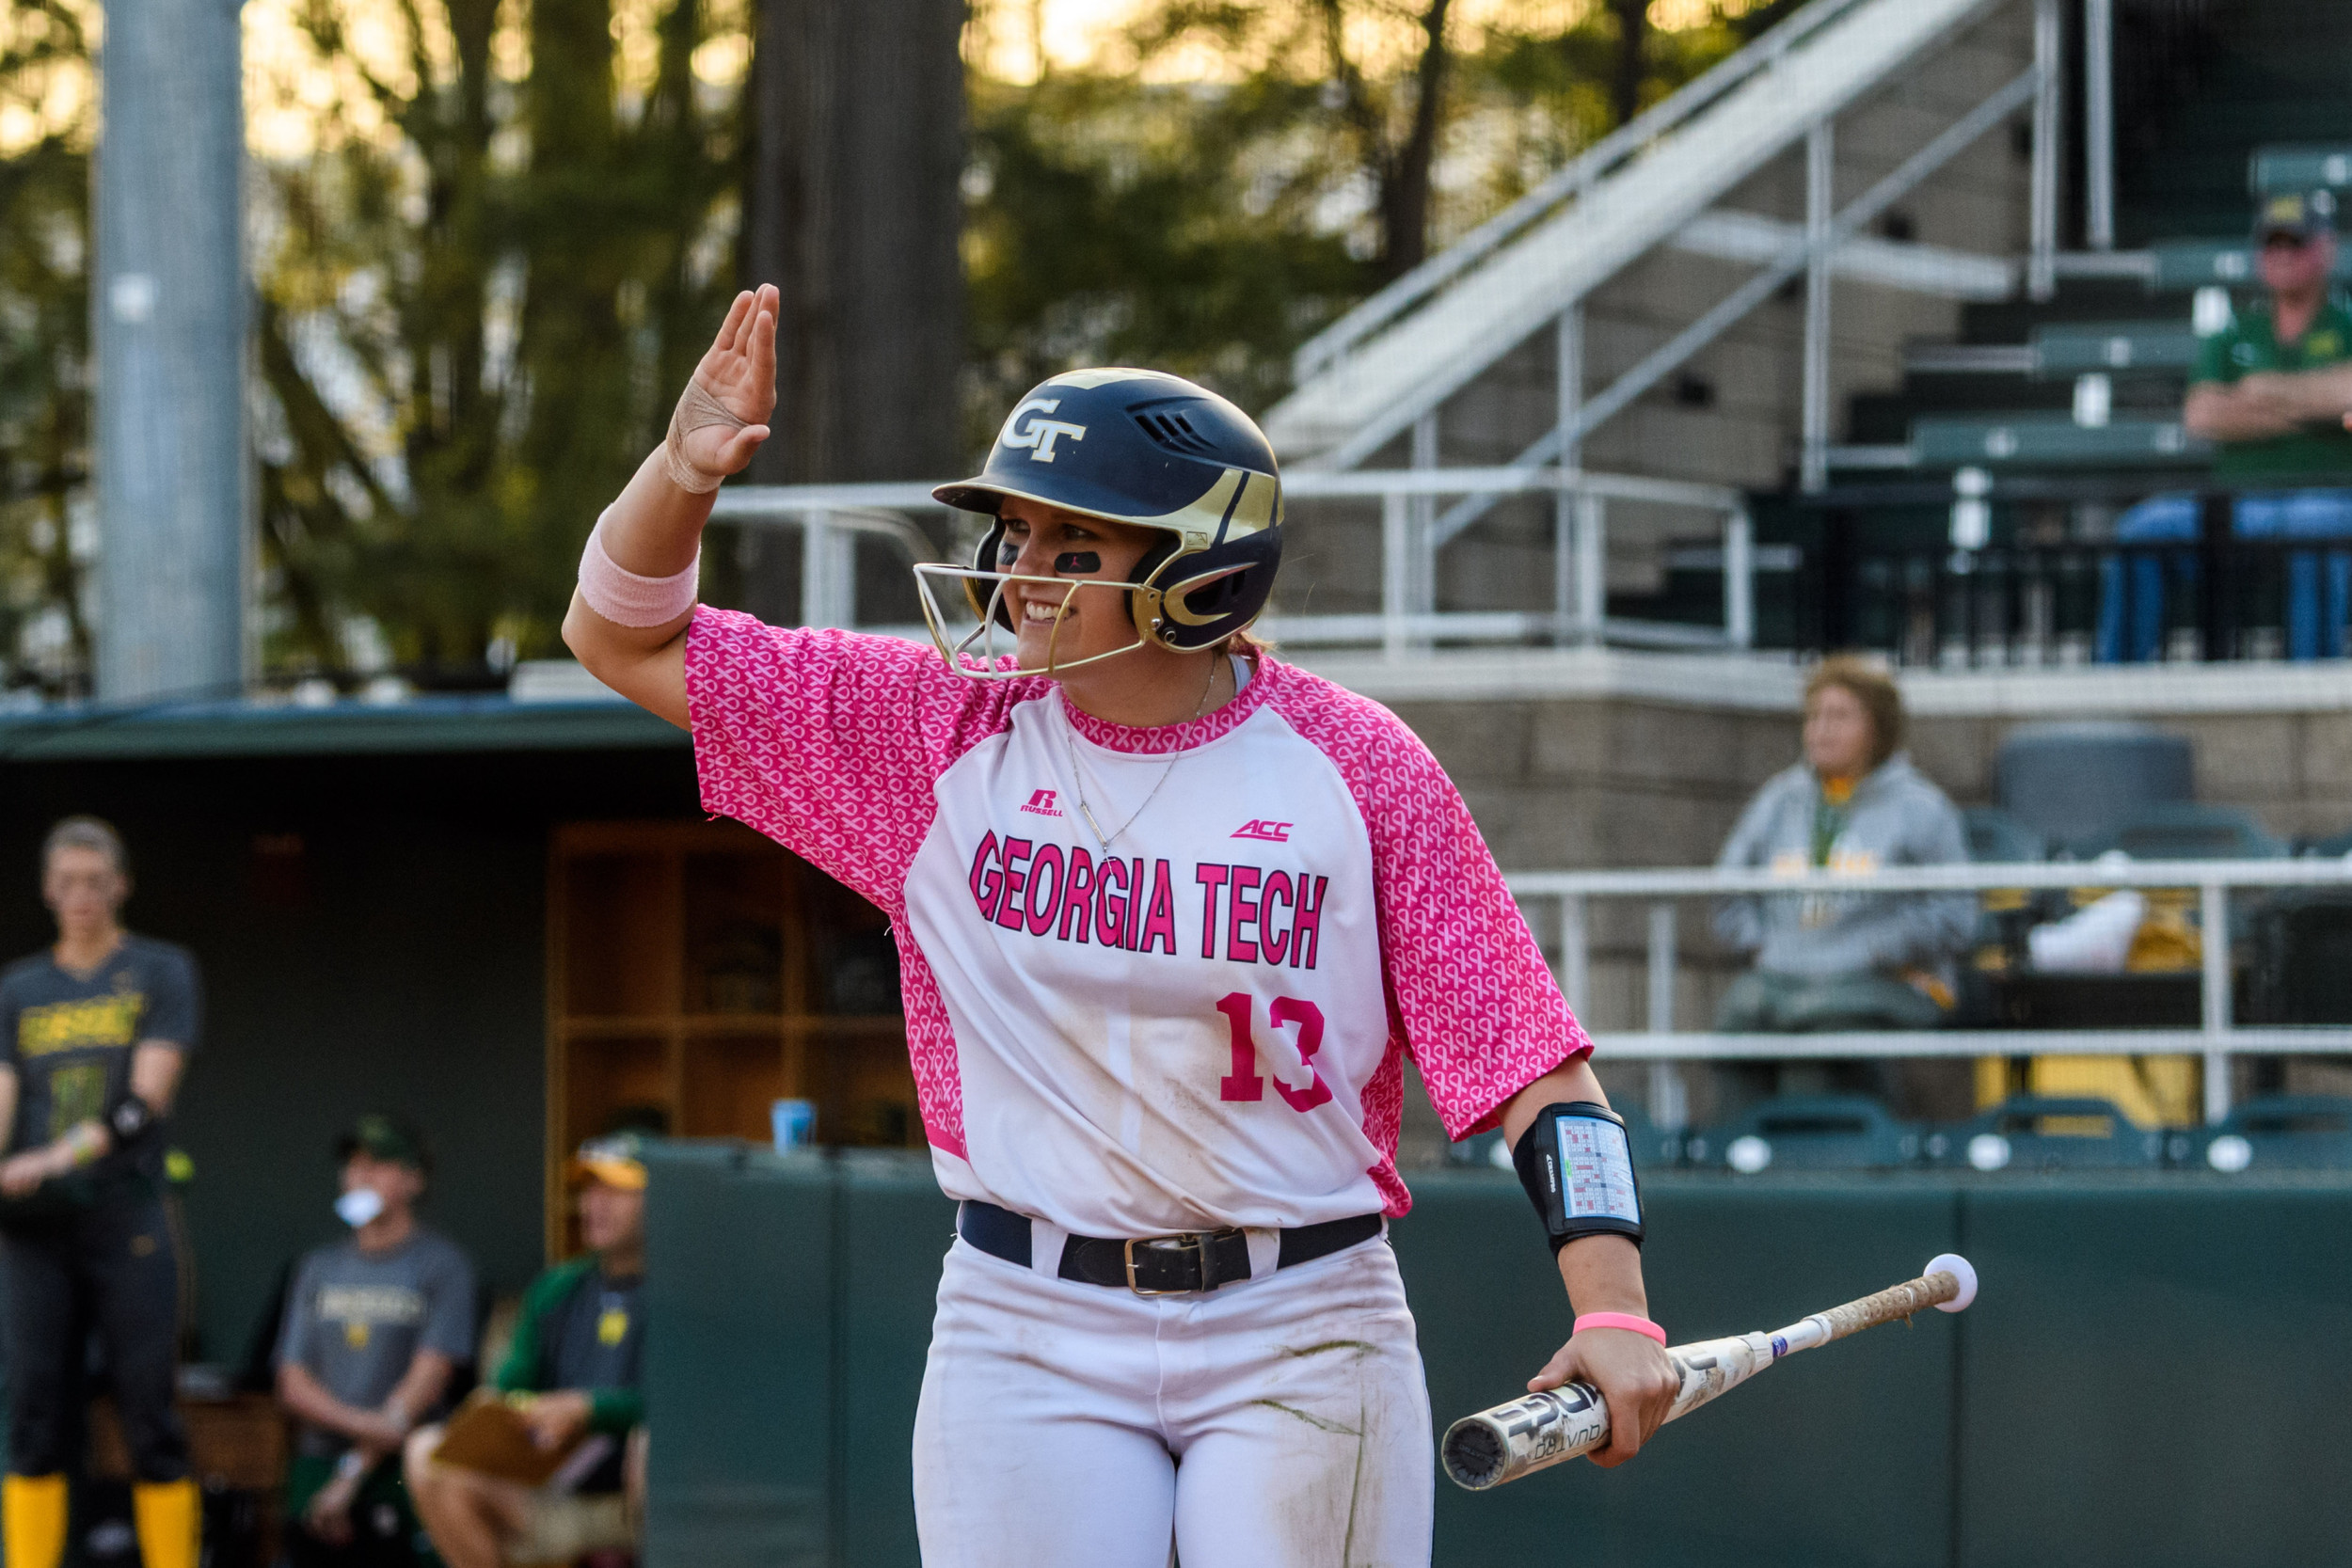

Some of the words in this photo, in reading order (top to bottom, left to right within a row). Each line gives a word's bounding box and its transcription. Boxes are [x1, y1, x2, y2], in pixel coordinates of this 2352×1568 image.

[1001, 399, 1087, 463] GT
[1020, 804, 1063, 817] RUSSELL
[1234, 819, 1295, 839] ACC
[969, 829, 1177, 956] GEORGIA
[1196, 862, 1329, 970] TECH
[1216, 991, 1333, 1113] 13
